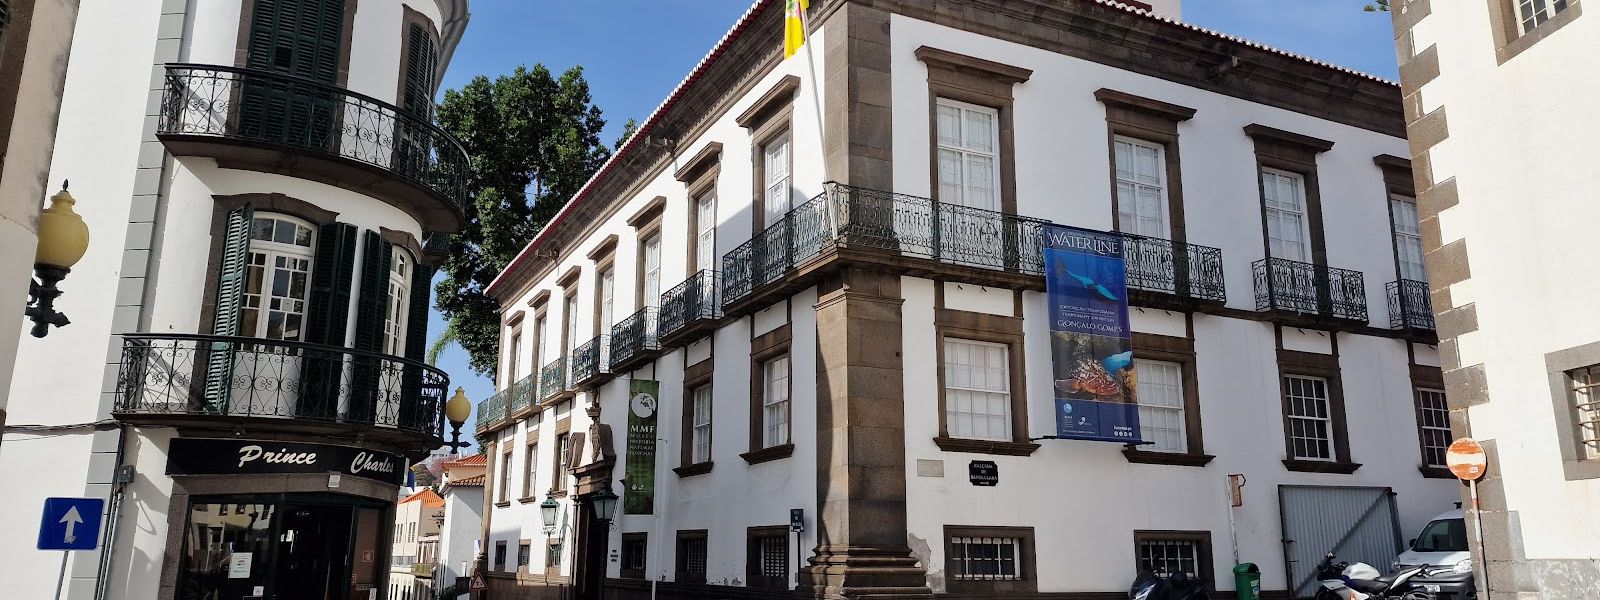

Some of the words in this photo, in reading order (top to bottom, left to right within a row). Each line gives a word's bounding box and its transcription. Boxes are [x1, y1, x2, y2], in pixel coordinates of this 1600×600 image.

[1057, 319, 1096, 330] GONÇALO
[1097, 324, 1123, 333] GOMES
[630, 424, 655, 433] MMF
[238, 445, 317, 467] Prince
[350, 451, 394, 474] Charles
